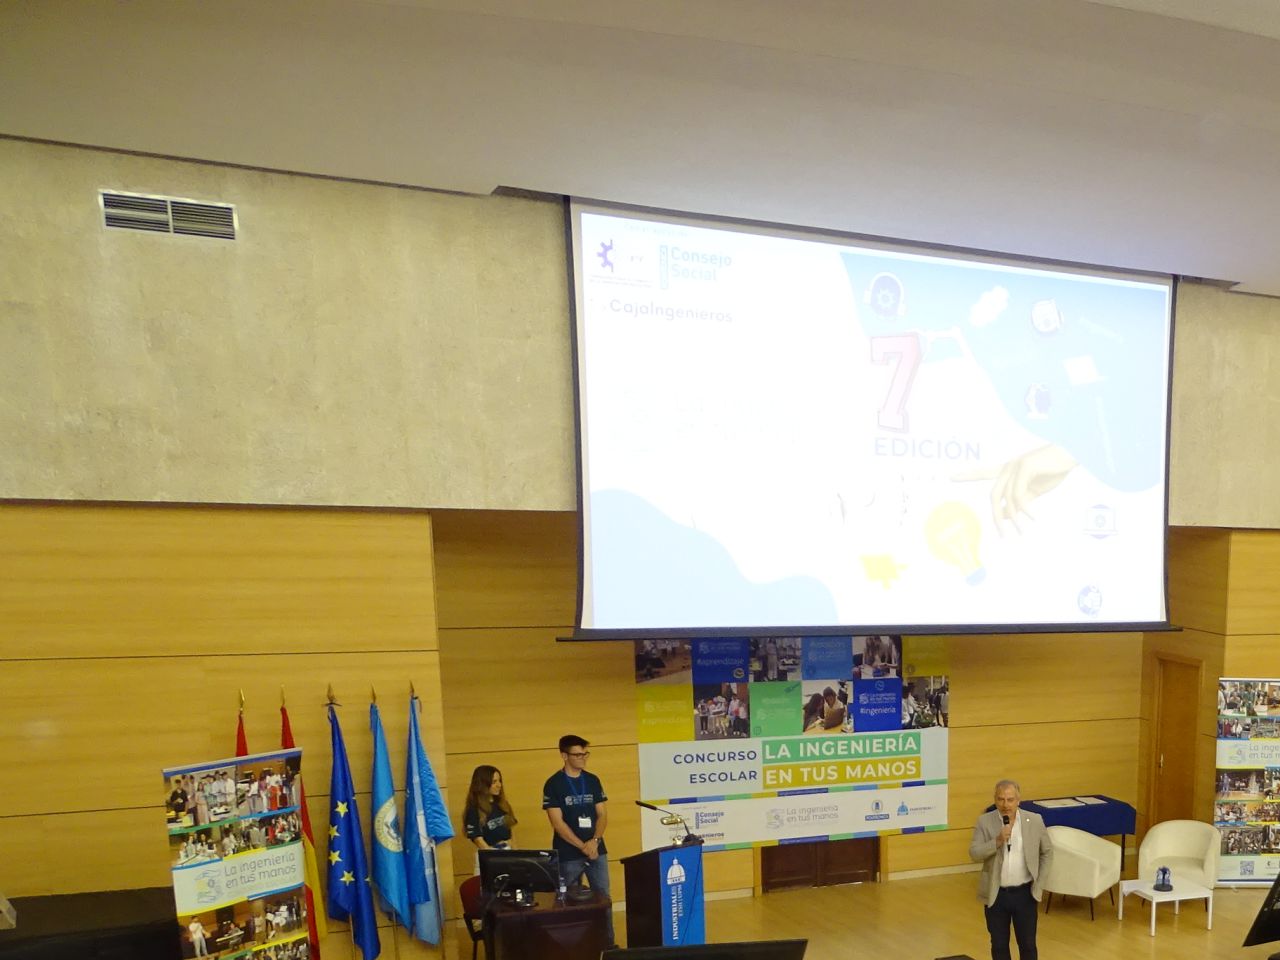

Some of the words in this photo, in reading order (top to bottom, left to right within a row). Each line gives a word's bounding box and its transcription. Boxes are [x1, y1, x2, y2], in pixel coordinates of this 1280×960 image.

[671, 246, 732, 268] Consejo
[671, 263, 717, 281] Social
[870, 332, 921, 433] 7
[873, 435, 981, 461] EDICIÓN
[673, 750, 758, 765] CONCURSO
[765, 743, 791, 760] LA
[799, 733, 918, 758] INGENIERÍA
[689, 770, 758, 784] ESCOLAR
[765, 767, 793, 785] EN
[800, 765, 839, 782] TUS
[845, 760, 918, 779] MANOS
[700, 811, 724, 819] Consejo
[224, 865, 238, 877] La
[226, 878, 239, 889] en
[240, 873, 256, 885] tus
[259, 864, 297, 881] manos
